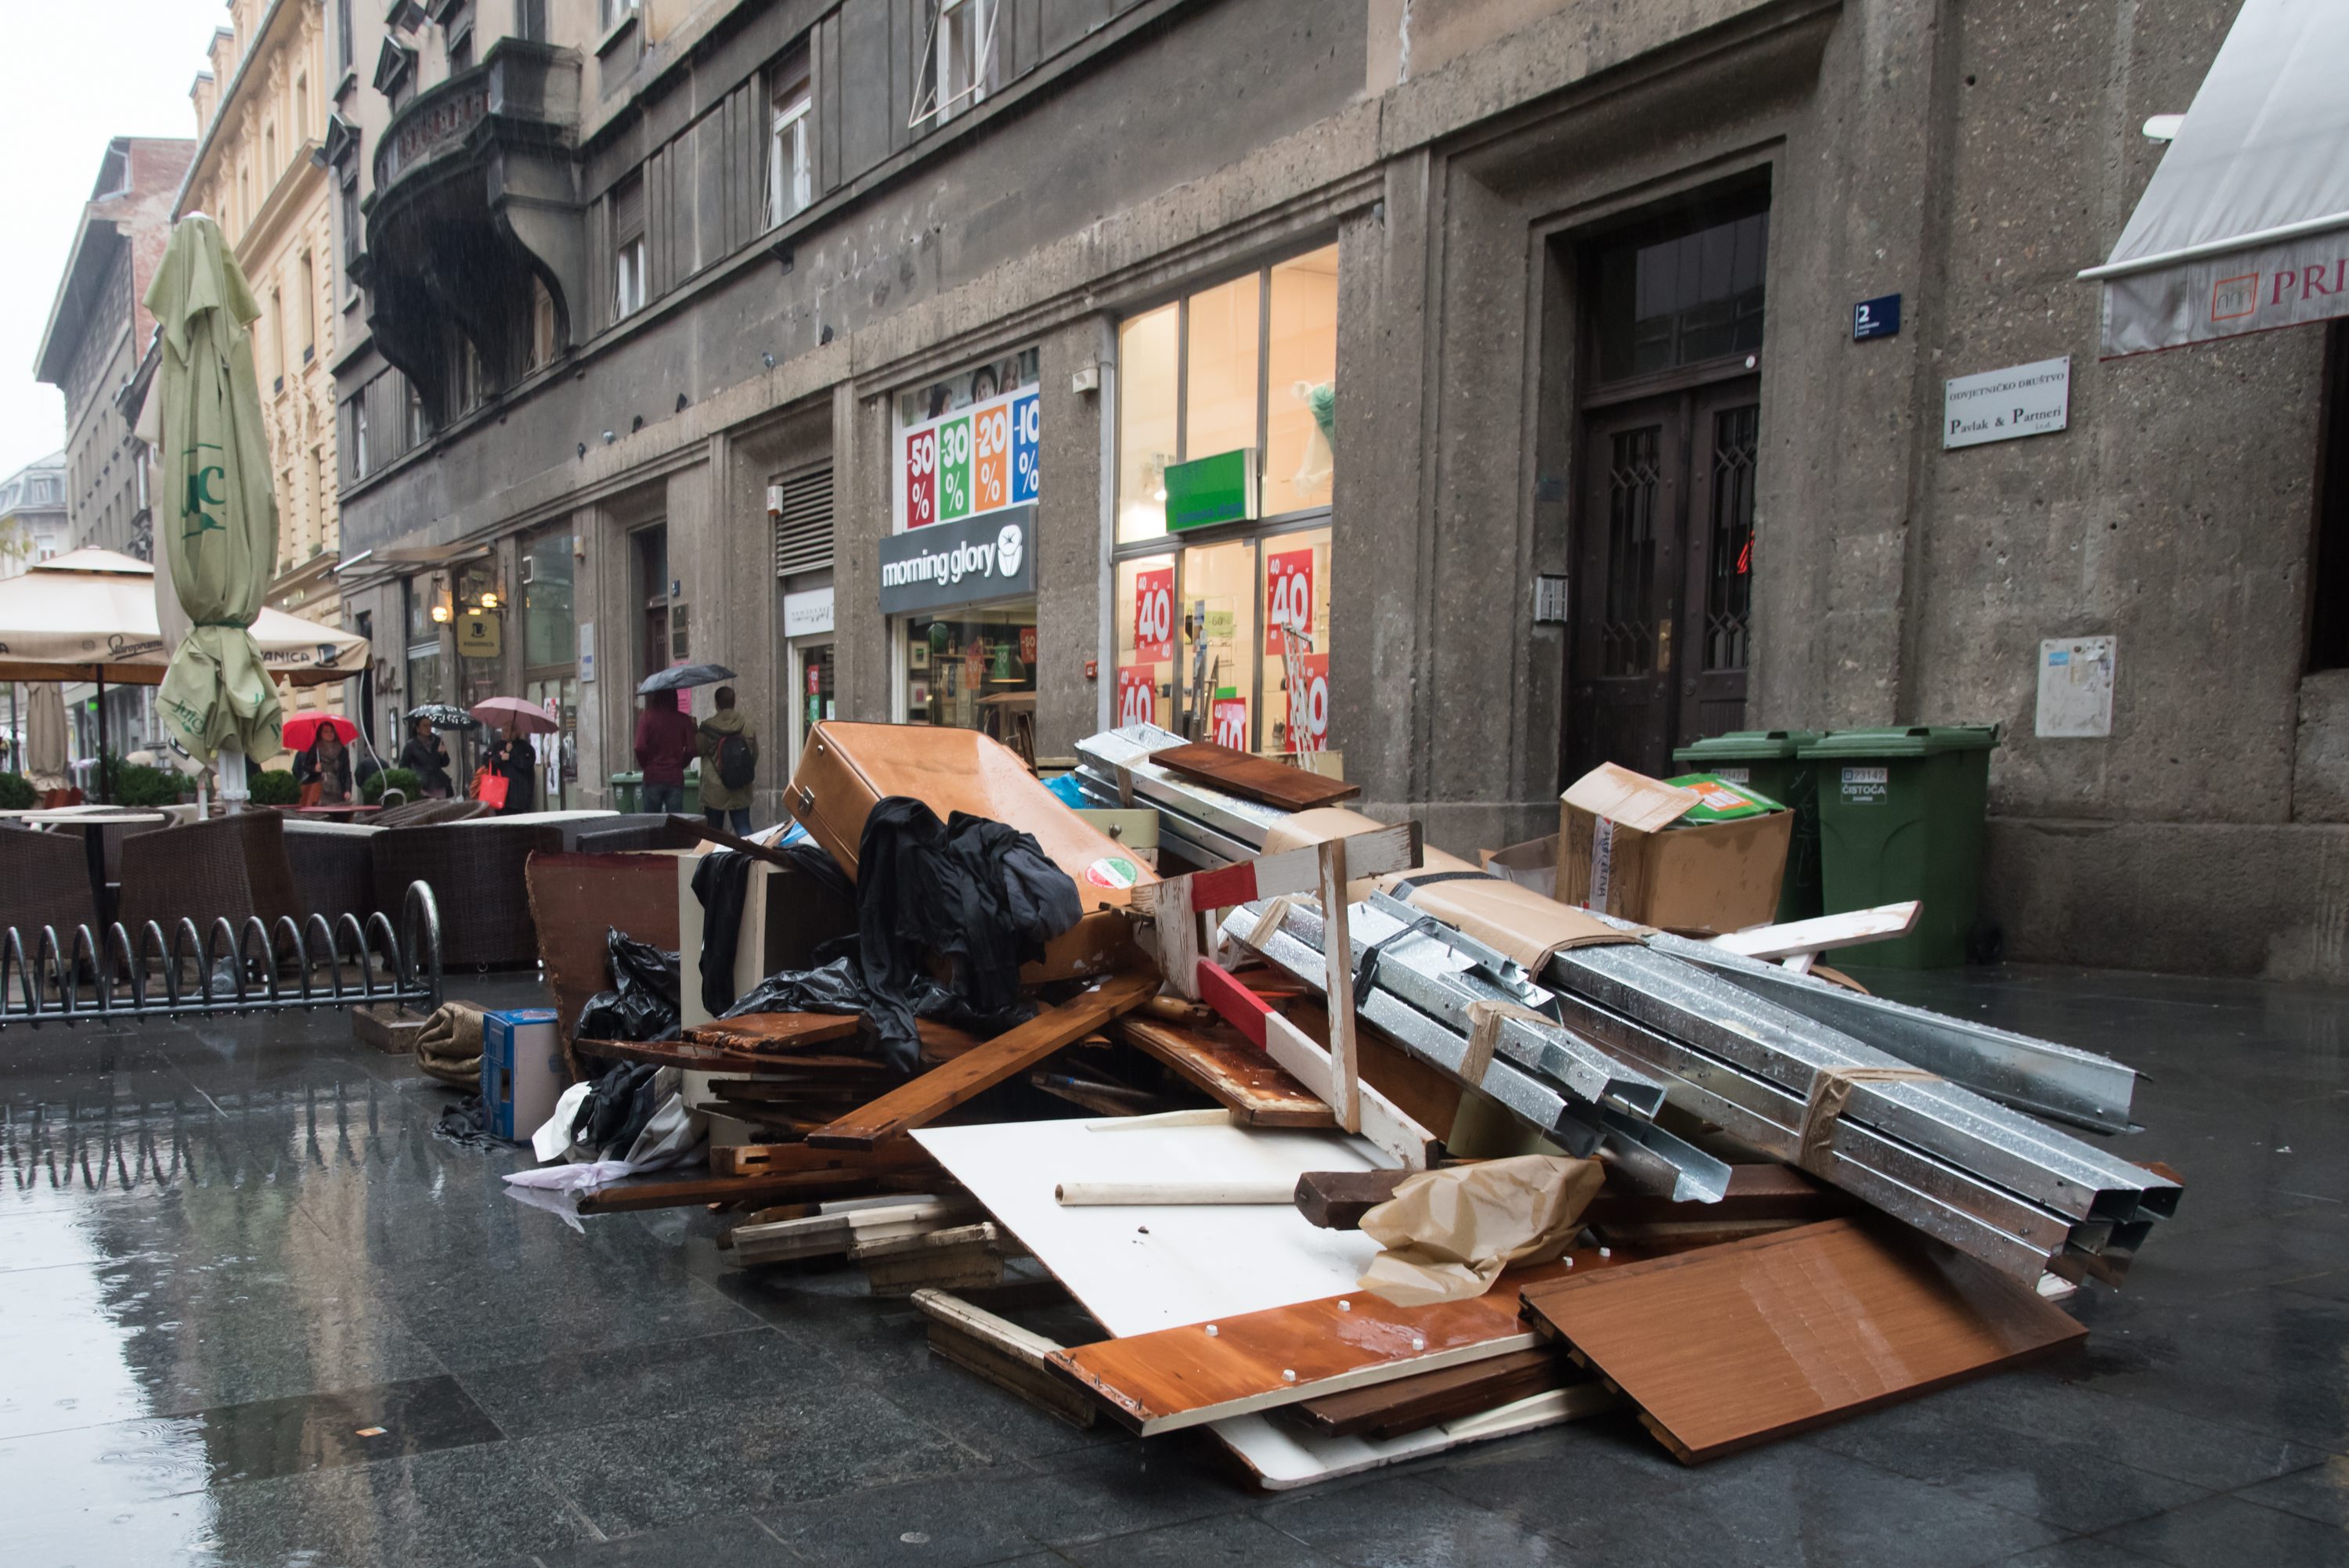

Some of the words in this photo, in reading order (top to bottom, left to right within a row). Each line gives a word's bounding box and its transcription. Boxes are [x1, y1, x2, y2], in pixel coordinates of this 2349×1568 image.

[1858, 305, 1870, 323] 2
[1949, 382, 2016, 402] ODVJETNIČKO
[2018, 372, 2065, 388] DRUŠTVO
[976, 411, 1006, 458] -20
[1013, 399, 1040, 445] -10
[1950, 418, 1989, 435] Pavlak
[1994, 416, 2005, 427] &
[2012, 405, 2062, 425] Partneri
[907, 434, 935, 478] -50
[940, 423, 969, 468] -30
[882, 549, 950, 587] morning
[950, 540, 997, 583] glory
[1138, 589, 1170, 643] 40
[1271, 571, 1308, 632] 40
[261, 651, 310, 663] ANICA
[1122, 684, 1151, 727] 40
[1842, 783, 1886, 795] ČISTOĆA
